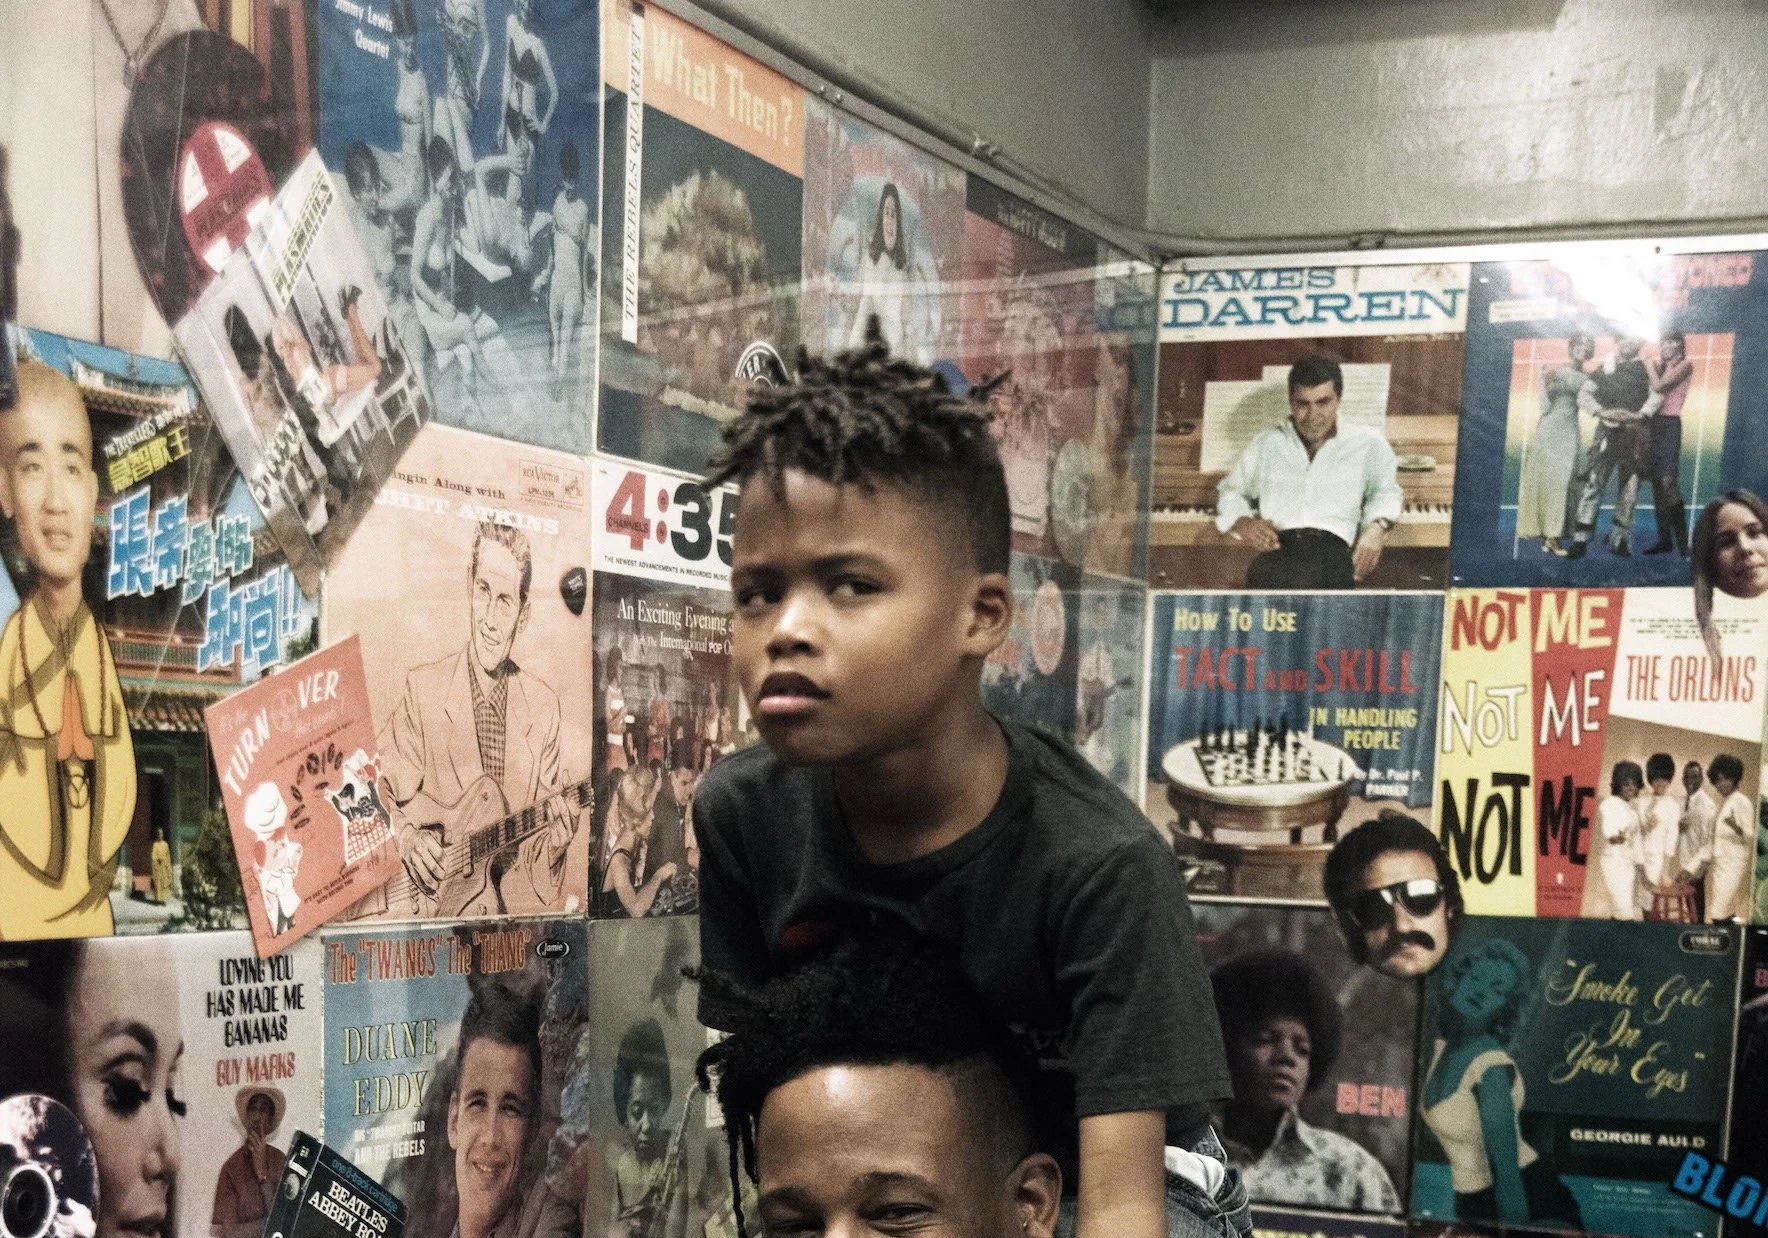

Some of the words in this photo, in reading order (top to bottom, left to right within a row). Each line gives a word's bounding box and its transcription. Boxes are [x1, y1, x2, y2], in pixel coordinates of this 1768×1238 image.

[367, 6, 393, 33] Lewis
[355, 28, 390, 60] Quartet
[628, 25, 642, 153] QUARTET
[652, 22, 718, 109] What
[724, 61, 793, 147] Then?
[626, 161, 640, 261] REBELS
[624, 273, 637, 321] THE
[1173, 267, 1336, 295] JAMES
[1162, 288, 1467, 329] DARREN
[434, 477, 472, 496] Along
[477, 486, 505, 499] with
[607, 516, 649, 534] CHANNELS
[616, 557, 637, 568] NEWEST
[639, 561, 678, 575] ADVANCEMENTS
[686, 568, 712, 580] RECORDED
[617, 597, 635, 621] An
[637, 599, 682, 631] Exciting
[685, 606, 727, 636] Evening
[1450, 591, 1527, 651] NOT
[1534, 590, 1613, 654] ME
[1173, 646, 1264, 691] TACT
[1314, 647, 1419, 693] SKILL
[1626, 655, 1662, 702] THE
[1310, 707, 1329, 726] IN
[1335, 707, 1417, 729] HANDLING
[1441, 677, 1528, 757] NOT
[1539, 669, 1606, 747] ME
[223, 707, 272, 797] TURN
[1344, 729, 1401, 750] PEOPLE
[1440, 772, 1531, 885] NOT
[1539, 775, 1596, 867] ME
[220, 957, 265, 986] LOVING
[269, 954, 294, 982] YOU
[331, 941, 357, 985] The
[446, 935, 472, 976] The
[206, 989, 235, 1019] HAS
[239, 985, 280, 1016] MADE
[283, 983, 305, 1011] ME
[224, 1014, 288, 1048] BANANAS
[342, 1018, 437, 1066] DUANE
[1596, 1007, 1642, 1050] In
[216, 1058, 242, 1087] GUY
[246, 1051, 295, 1083] MARKS
[352, 1070, 429, 1117] EDDY
[1335, 1082, 1406, 1118] BEN
[392, 1139, 426, 1159] REBELS
[1569, 1127, 1652, 1147] GEORGIE
[1656, 1134, 1706, 1149] AULD
[307, 1190, 358, 1233] ABBEY
[327, 1180, 389, 1234] BEATLES
